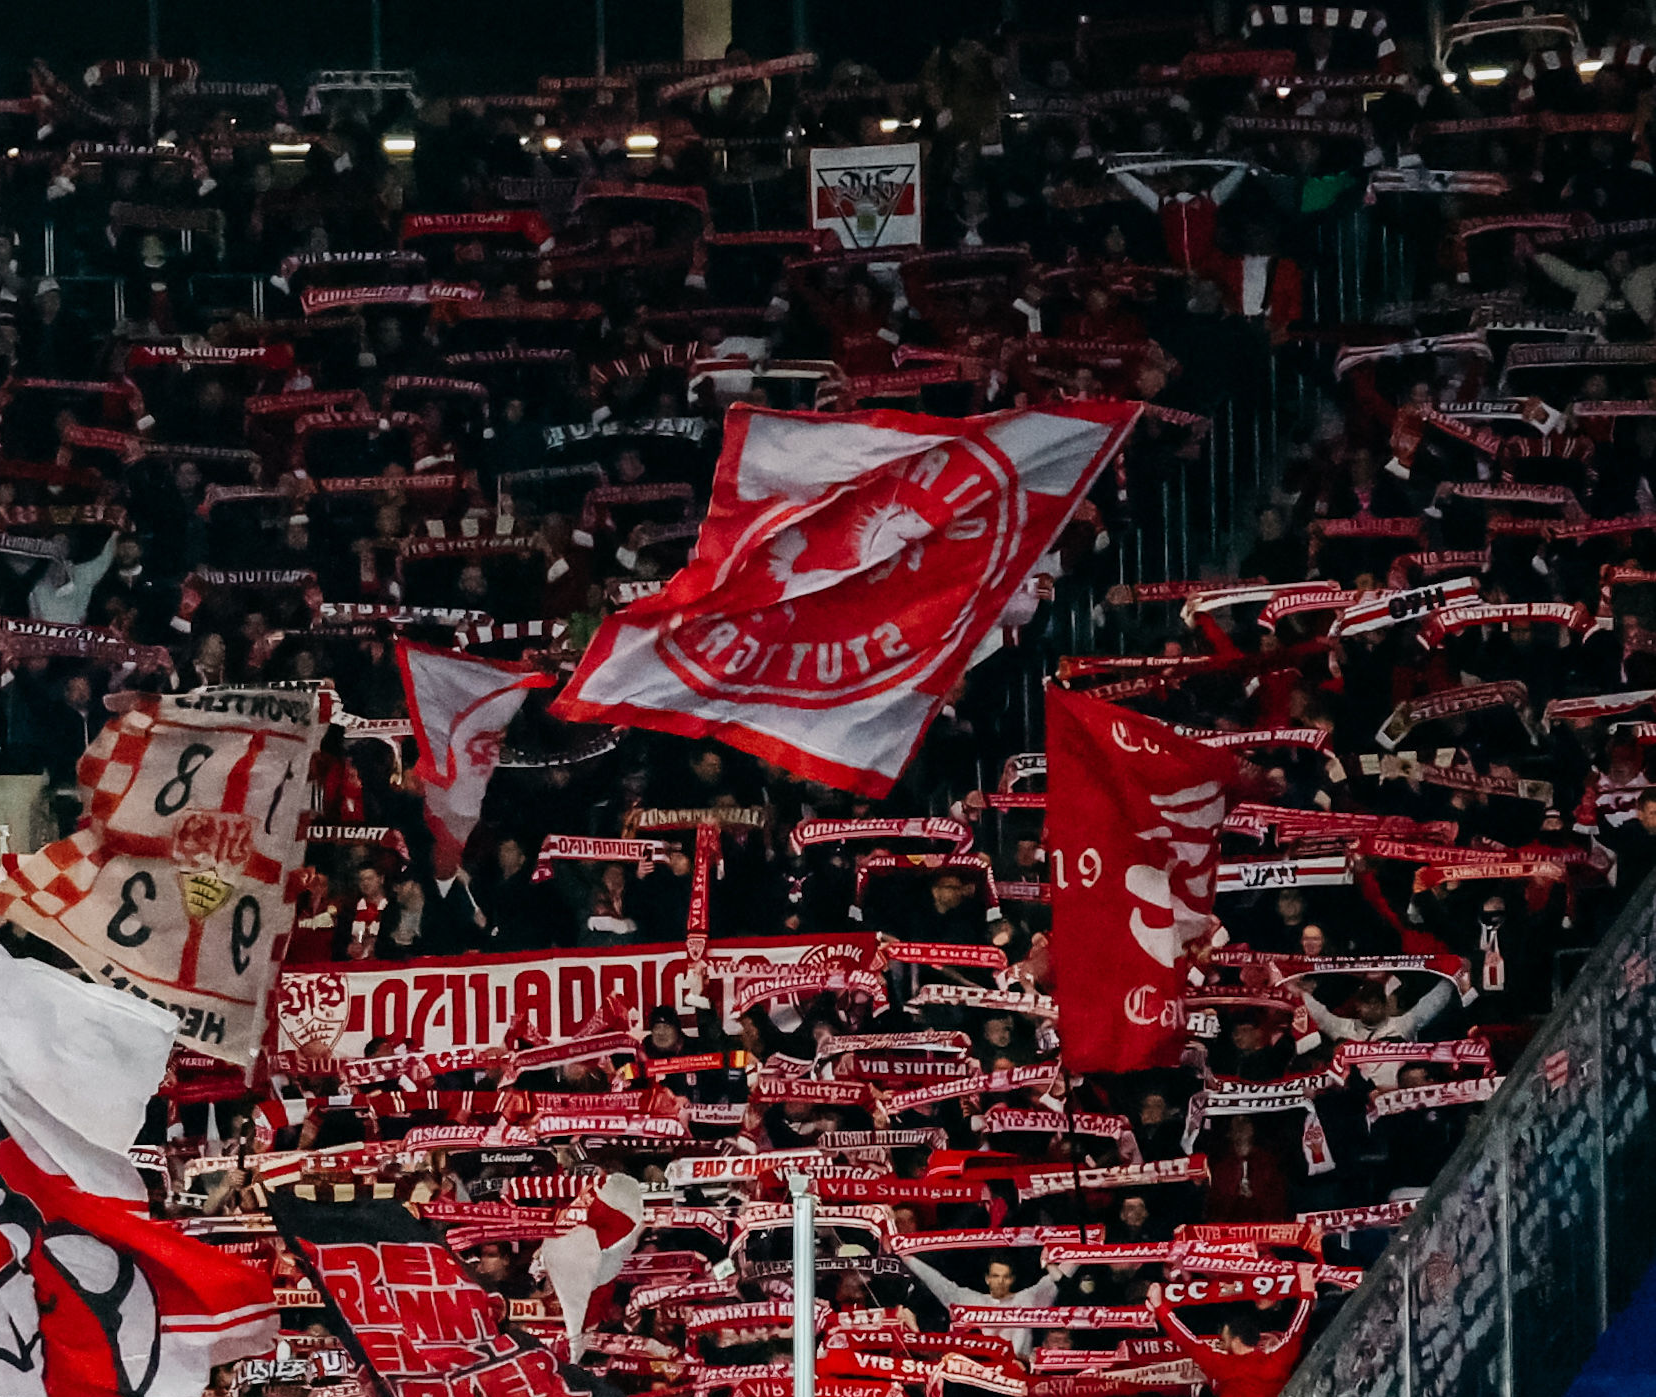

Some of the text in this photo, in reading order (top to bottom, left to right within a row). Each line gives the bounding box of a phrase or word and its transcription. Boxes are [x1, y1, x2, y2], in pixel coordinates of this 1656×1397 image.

[1051, 846, 1104, 890] 19
[827, 1184, 975, 1200] VfB Stuttgart
[1165, 1275, 1295, 1302] CC 97
[954, 1306, 1056, 1324] Cannstatter
